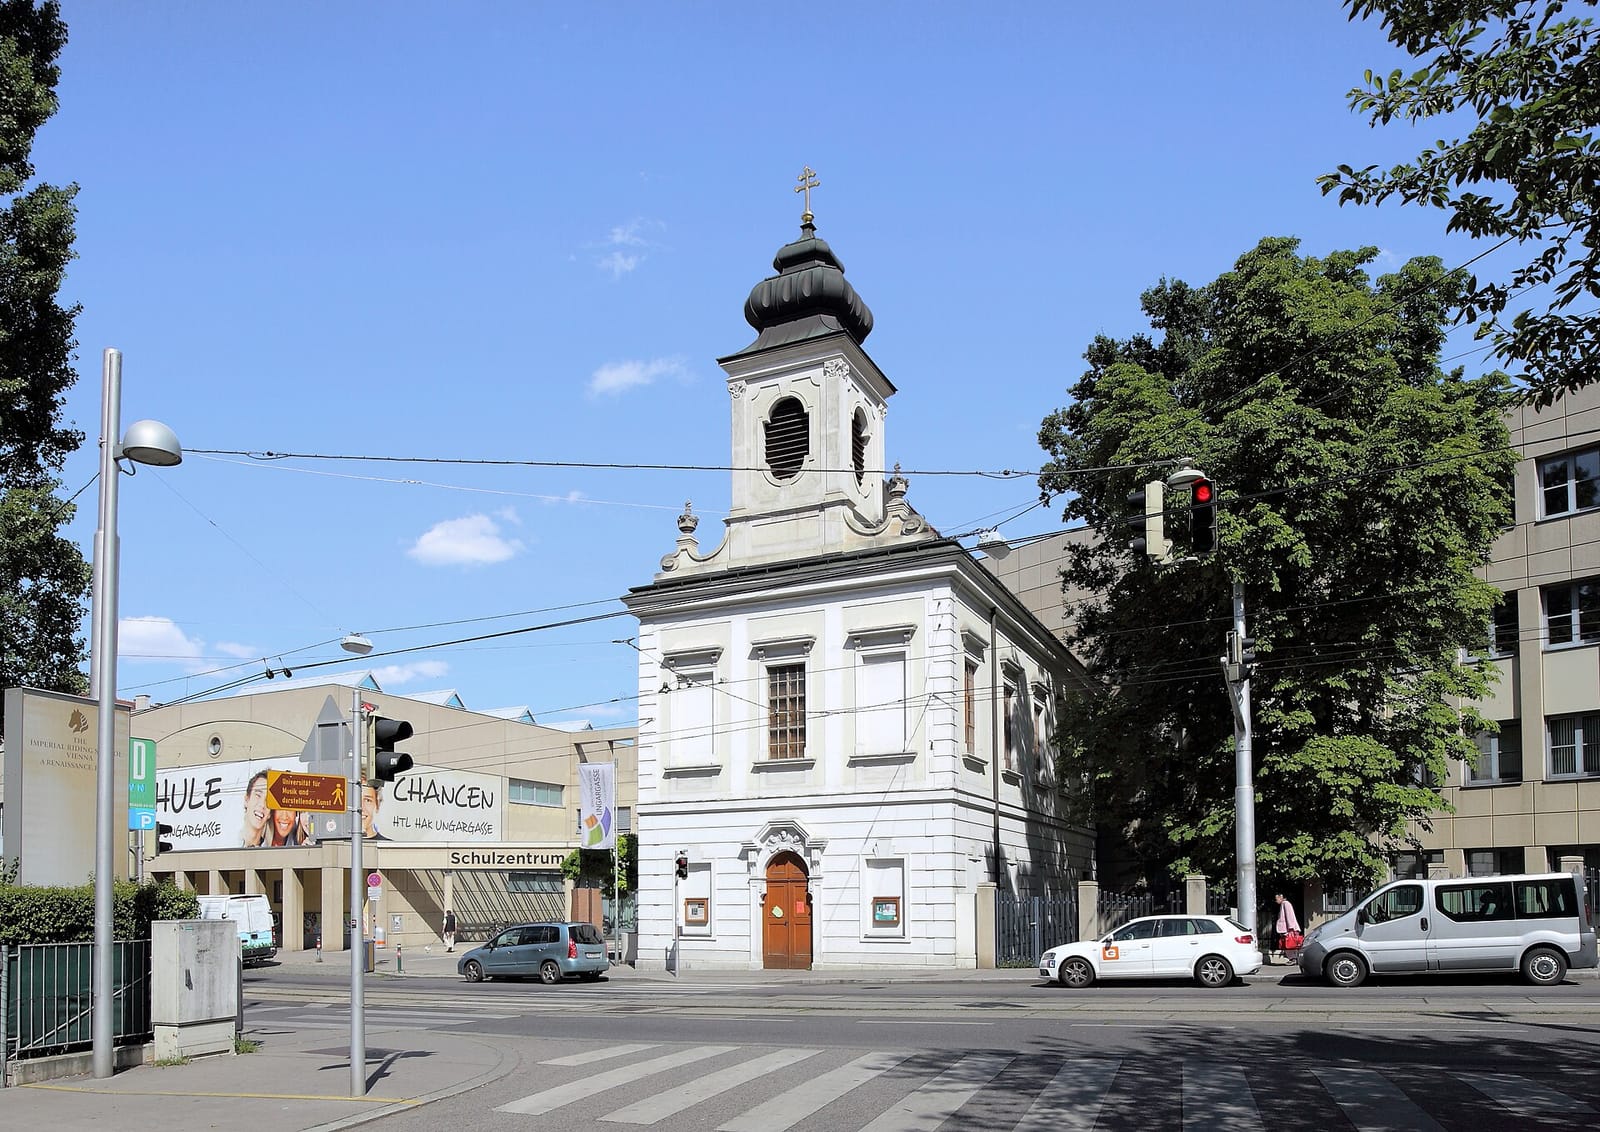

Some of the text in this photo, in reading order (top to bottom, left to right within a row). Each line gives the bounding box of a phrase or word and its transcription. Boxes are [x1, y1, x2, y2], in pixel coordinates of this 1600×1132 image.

[30, 738, 65, 750] IMPERIAL
[67, 744, 94, 754] RIDING
[73, 737, 87, 745] THE
[66, 752, 93, 762] VIENNA
[47, 760, 92, 771] RENAISSANCE
[282, 778, 311, 787] Universität
[156, 777, 222, 814] HULE
[282, 787, 309, 796] Musik und
[393, 776, 494, 809] CHANCEN
[592, 768, 603, 816] UNGARGASSE
[282, 796, 332, 806] darstellende Kunst
[393, 816, 493, 835] HTL HAK UNGARGASSE
[450, 851, 565, 865] Schulzentrum
